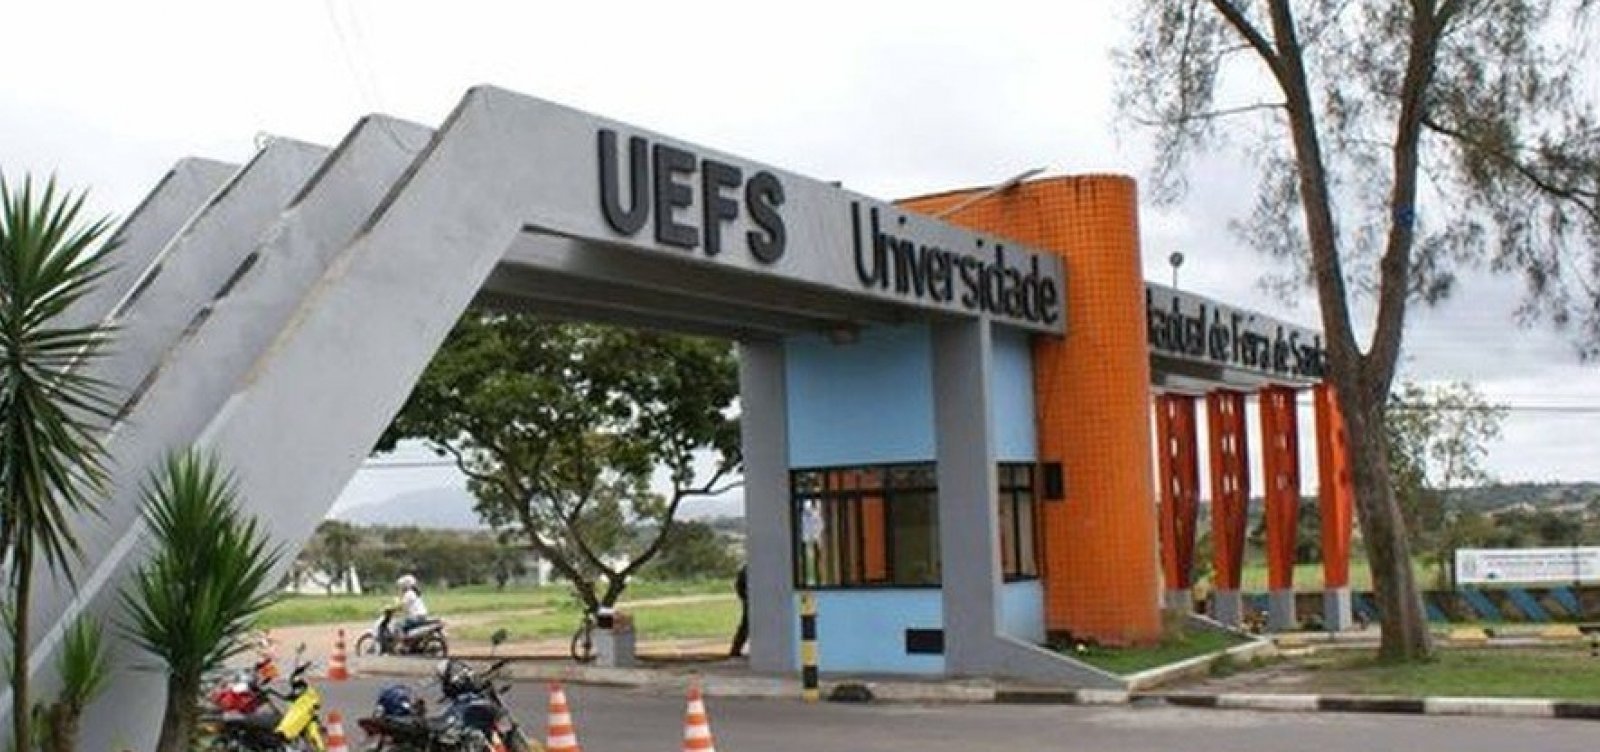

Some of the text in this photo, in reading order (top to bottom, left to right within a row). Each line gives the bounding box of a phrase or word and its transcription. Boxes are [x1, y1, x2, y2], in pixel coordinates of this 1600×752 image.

[598, 129, 1058, 324] UEFS Universidade
[1209, 306, 1229, 362] de
[1231, 312, 1270, 371] Feira
[1274, 326, 1289, 373] de
